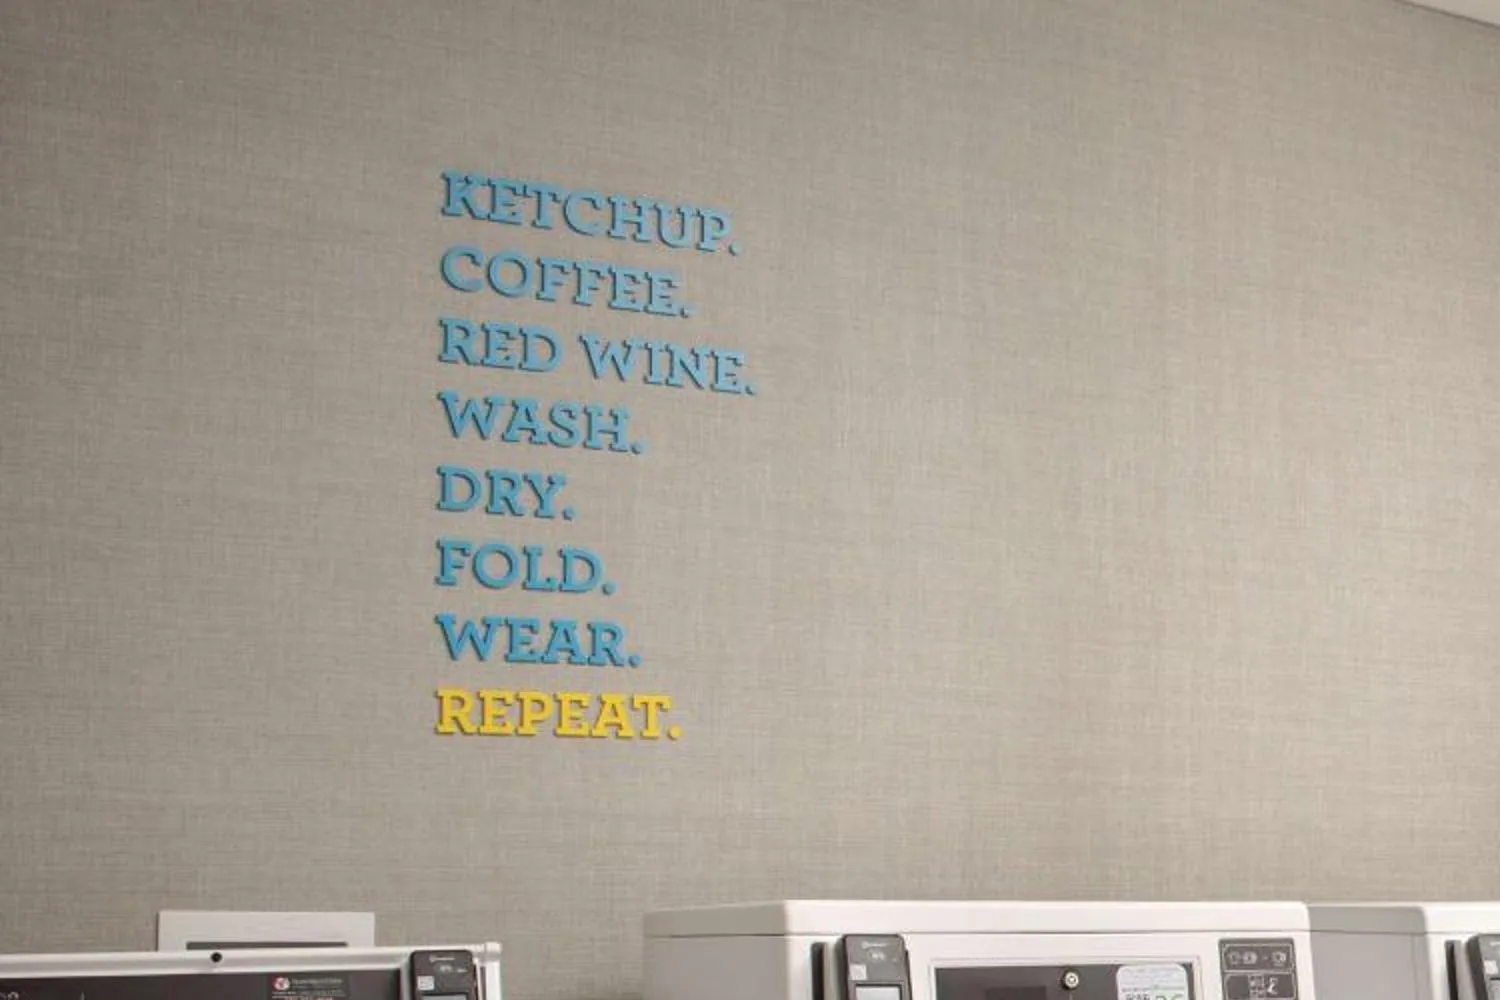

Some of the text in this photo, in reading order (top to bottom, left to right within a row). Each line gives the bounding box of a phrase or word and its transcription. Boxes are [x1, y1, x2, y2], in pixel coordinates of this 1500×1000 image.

[441, 172, 741, 256] KETCHUP.
[440, 245, 694, 318] COFFEE.
[438, 317, 756, 395] RED WINE.
[437, 390, 645, 454] WASH.
[436, 465, 576, 521] DRY.
[435, 538, 617, 596] FOLD.
[434, 613, 643, 668] WEAR.
[434, 687, 684, 740] REPEAT.
